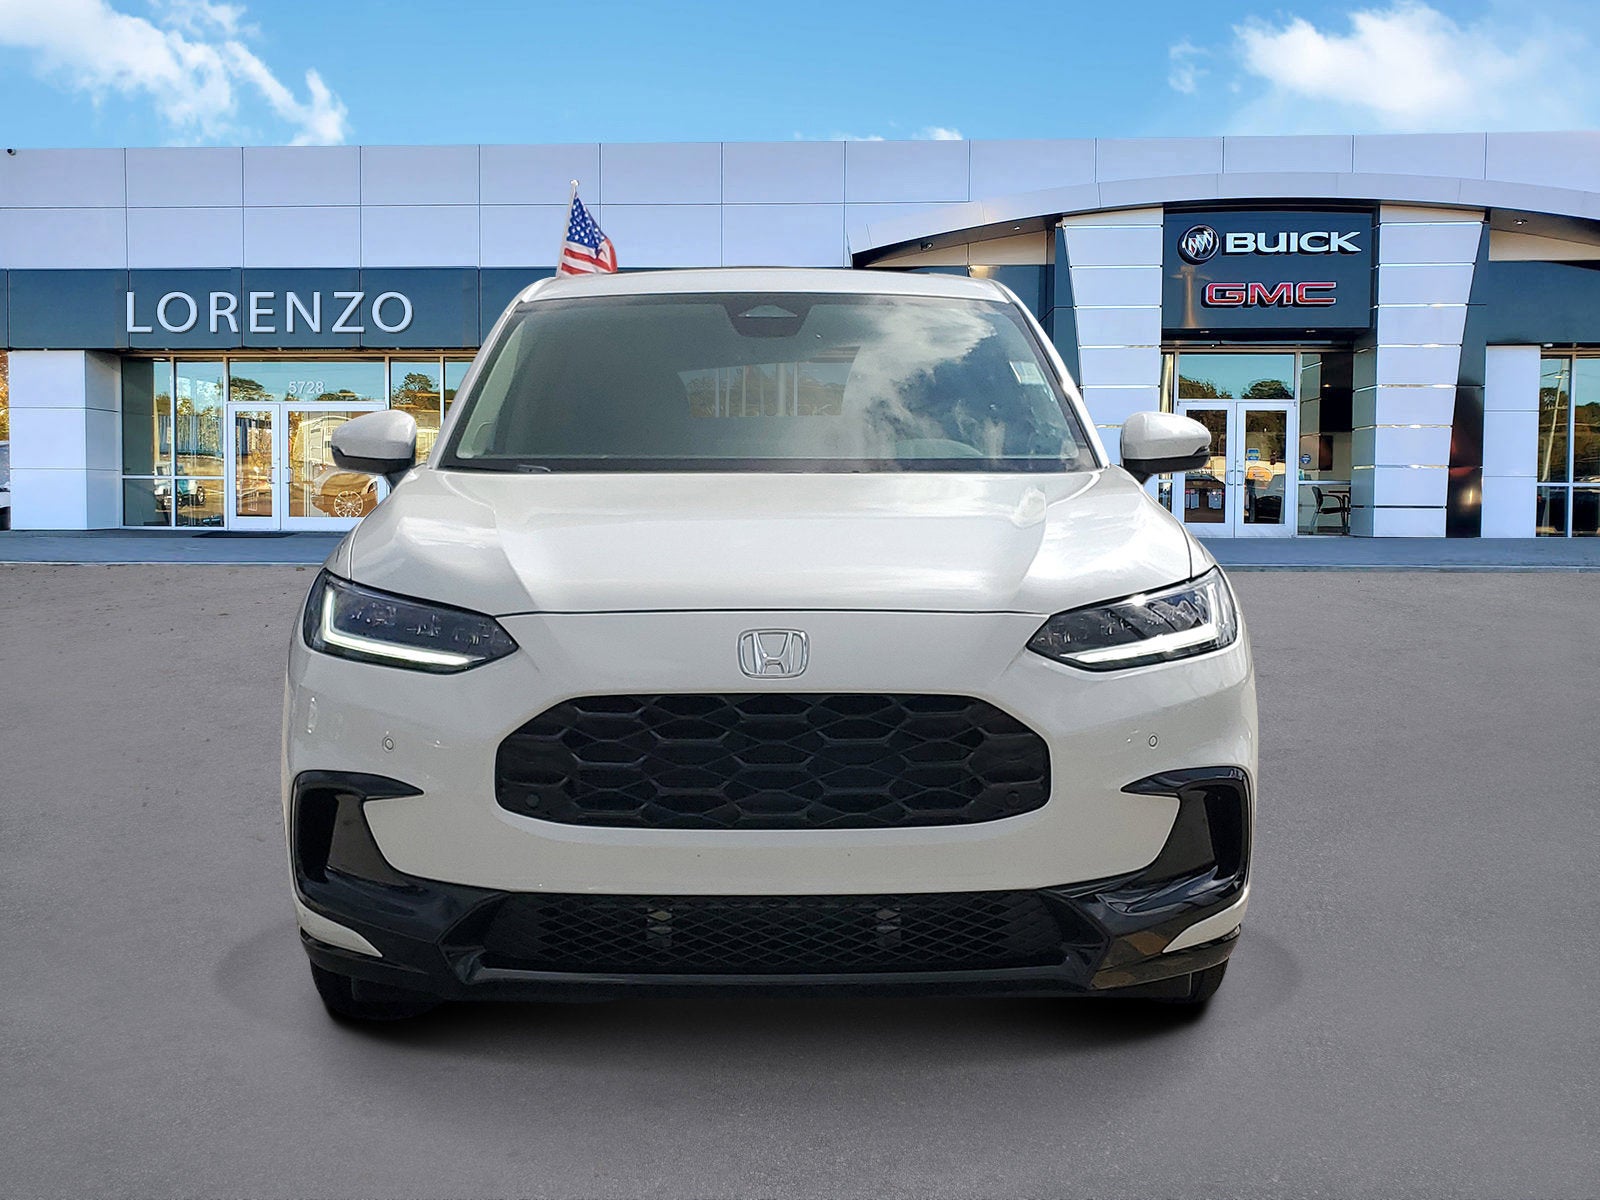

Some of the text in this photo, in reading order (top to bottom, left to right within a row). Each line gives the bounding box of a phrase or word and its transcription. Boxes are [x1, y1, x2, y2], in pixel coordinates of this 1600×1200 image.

[1225, 231, 1362, 253] BUICK
[1206, 282, 1337, 305] GMC
[126, 291, 414, 333] LORENZO
[288, 380, 325, 395] 5728
